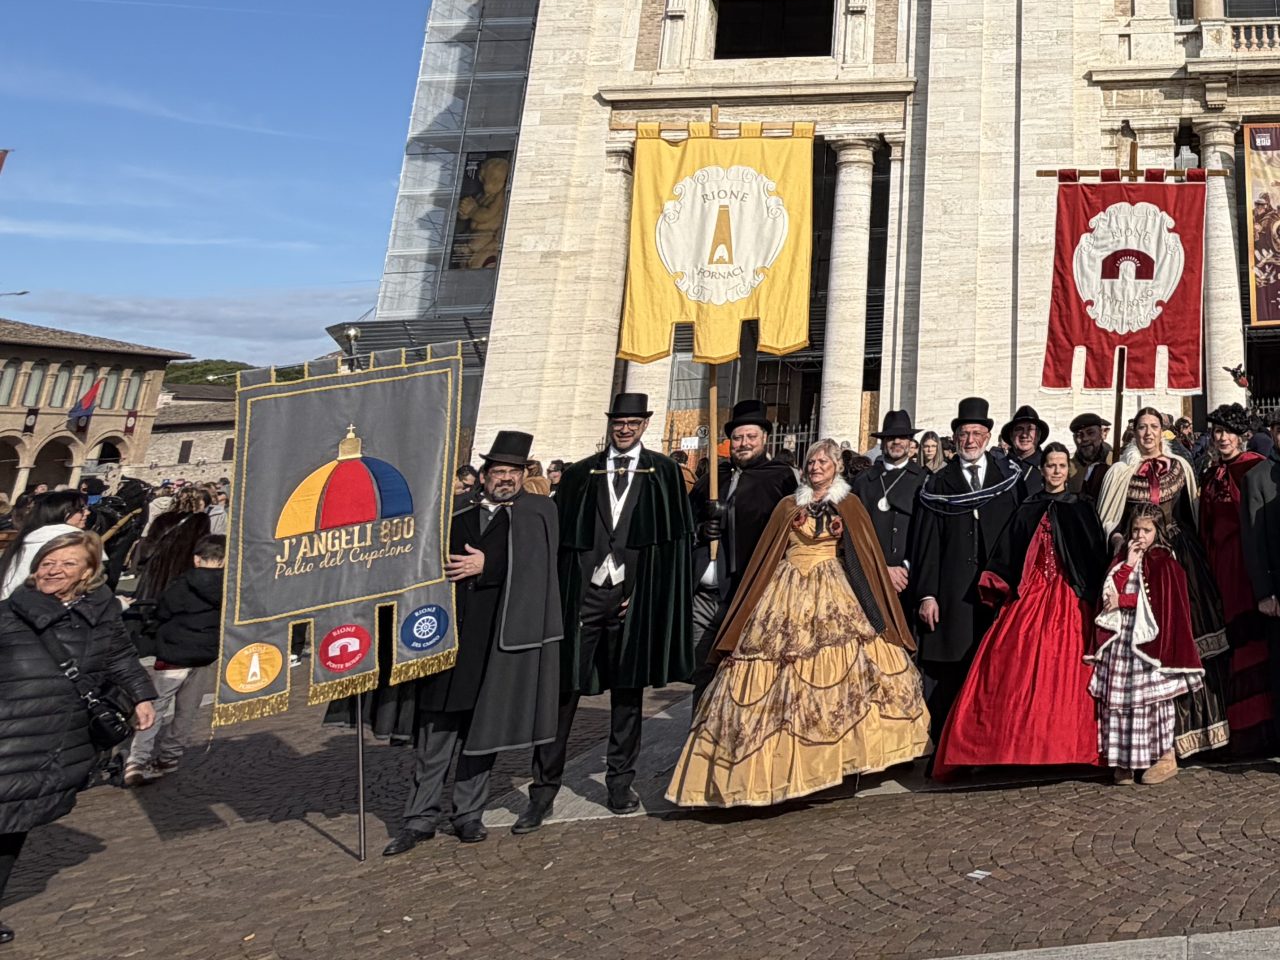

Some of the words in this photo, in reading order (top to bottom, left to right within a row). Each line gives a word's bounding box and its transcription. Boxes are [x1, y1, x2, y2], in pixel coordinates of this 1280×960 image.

[701, 189, 750, 204] RIONE
[697, 265, 745, 280] FORNACI
[379, 516, 416, 543] 800
[274, 558, 314, 580] Palio
[319, 549, 345, 569] del
[349, 540, 414, 569] Cupolone
[332, 626, 356, 637] RIONE
